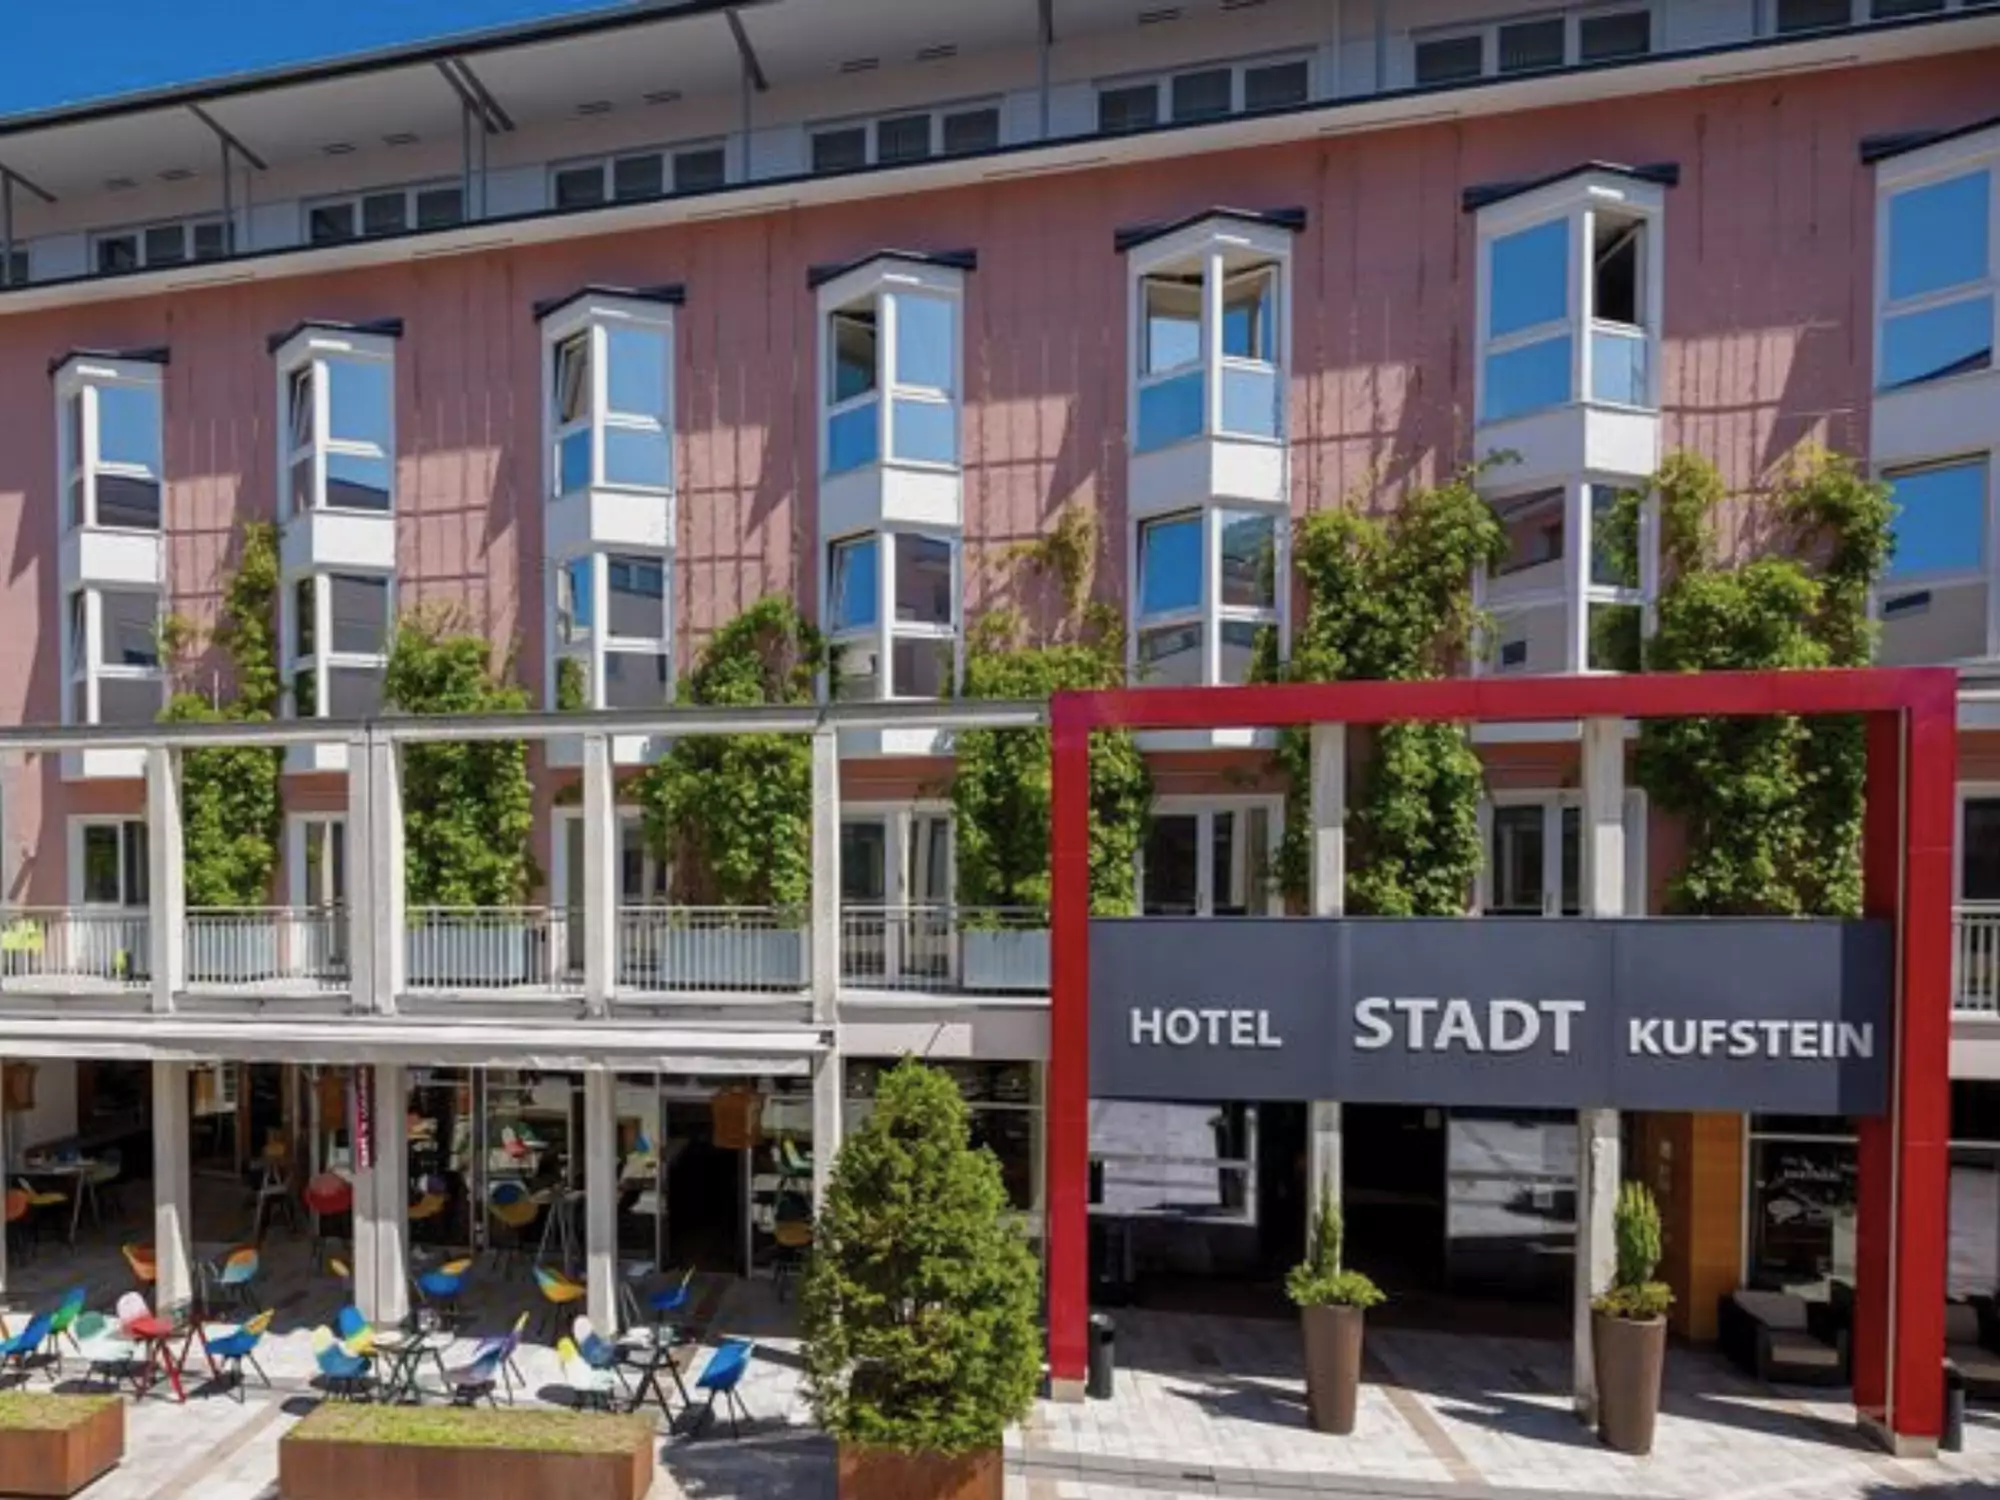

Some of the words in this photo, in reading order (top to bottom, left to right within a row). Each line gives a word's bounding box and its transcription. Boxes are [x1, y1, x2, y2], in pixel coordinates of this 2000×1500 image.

[1130, 1007, 1283, 1048] HOTEL
[1353, 996, 1587, 1053] STADT
[1628, 1017, 1874, 1060] KUFSTEIN
